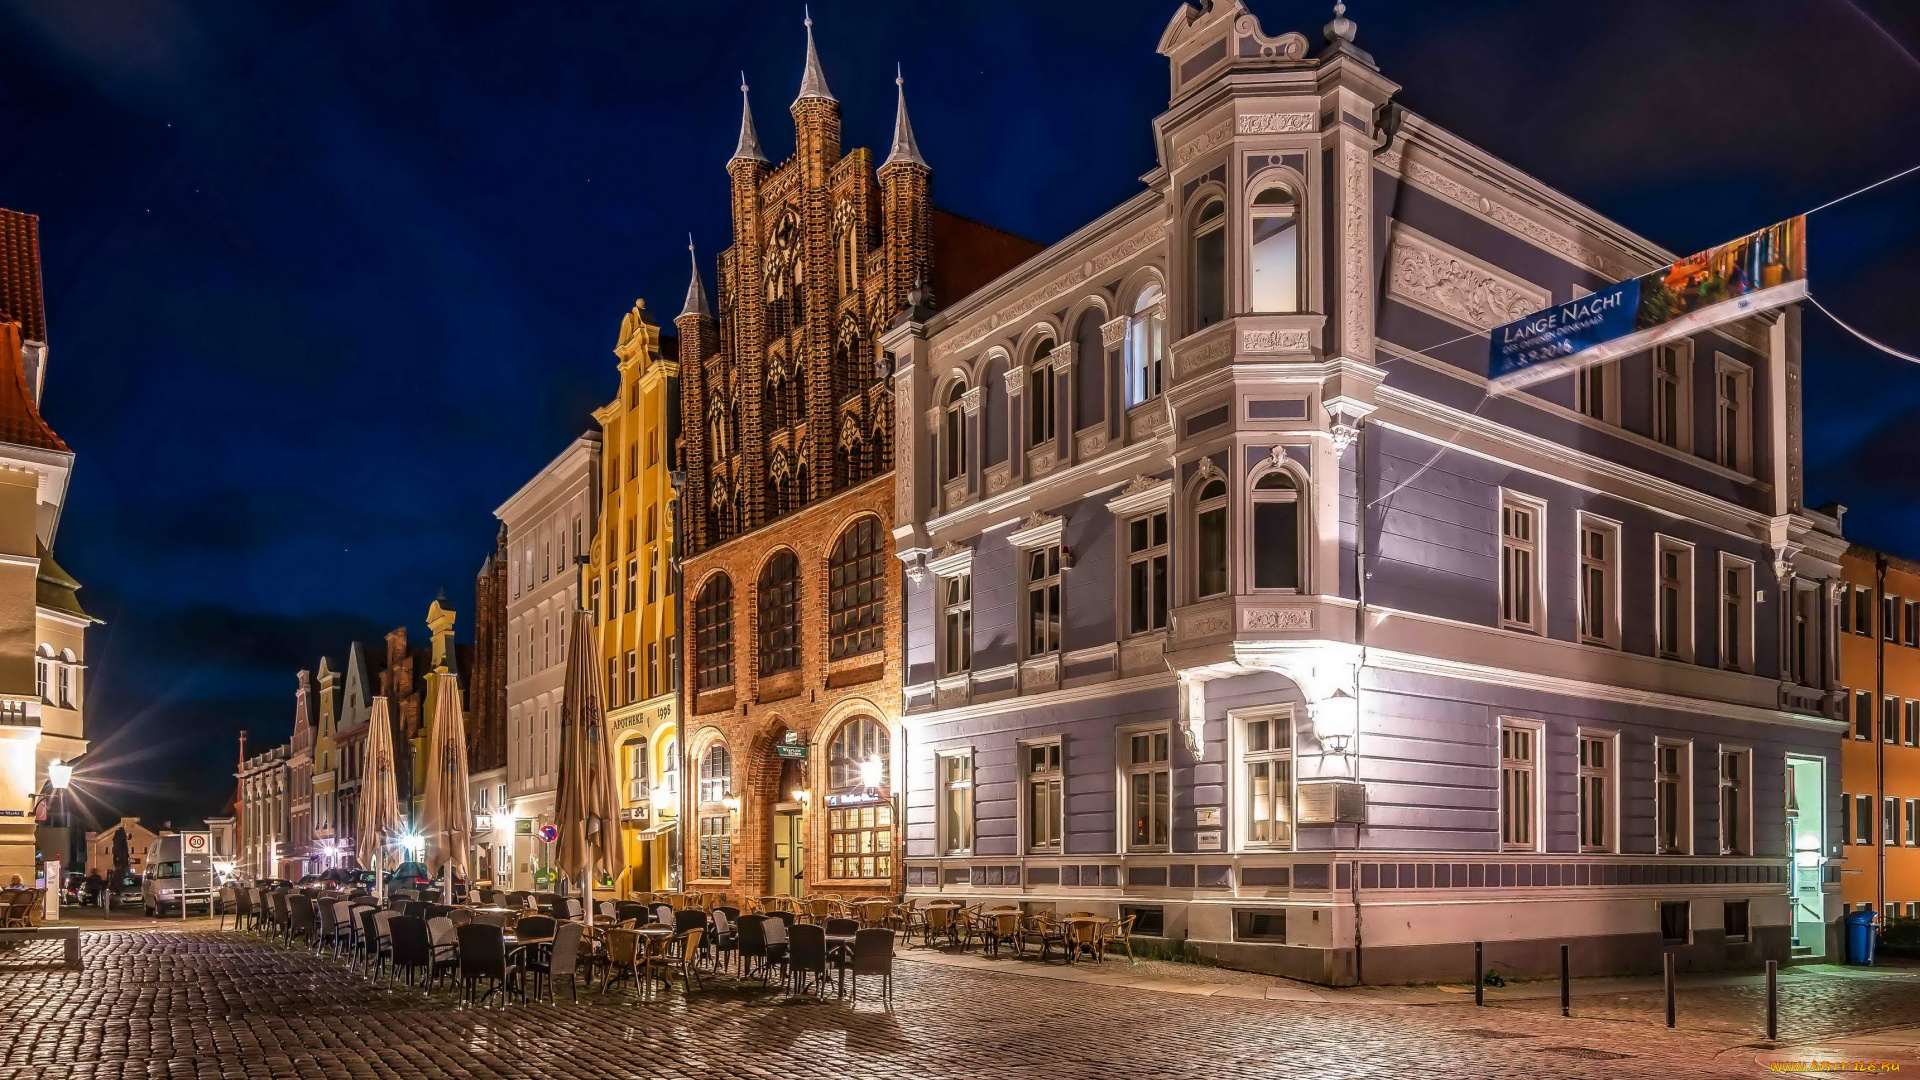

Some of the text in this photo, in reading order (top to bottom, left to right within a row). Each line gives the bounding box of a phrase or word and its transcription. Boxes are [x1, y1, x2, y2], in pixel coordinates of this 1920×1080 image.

[1504, 291, 1622, 343] LANGE NACHT
[614, 713, 643, 730] APOTHEKE
